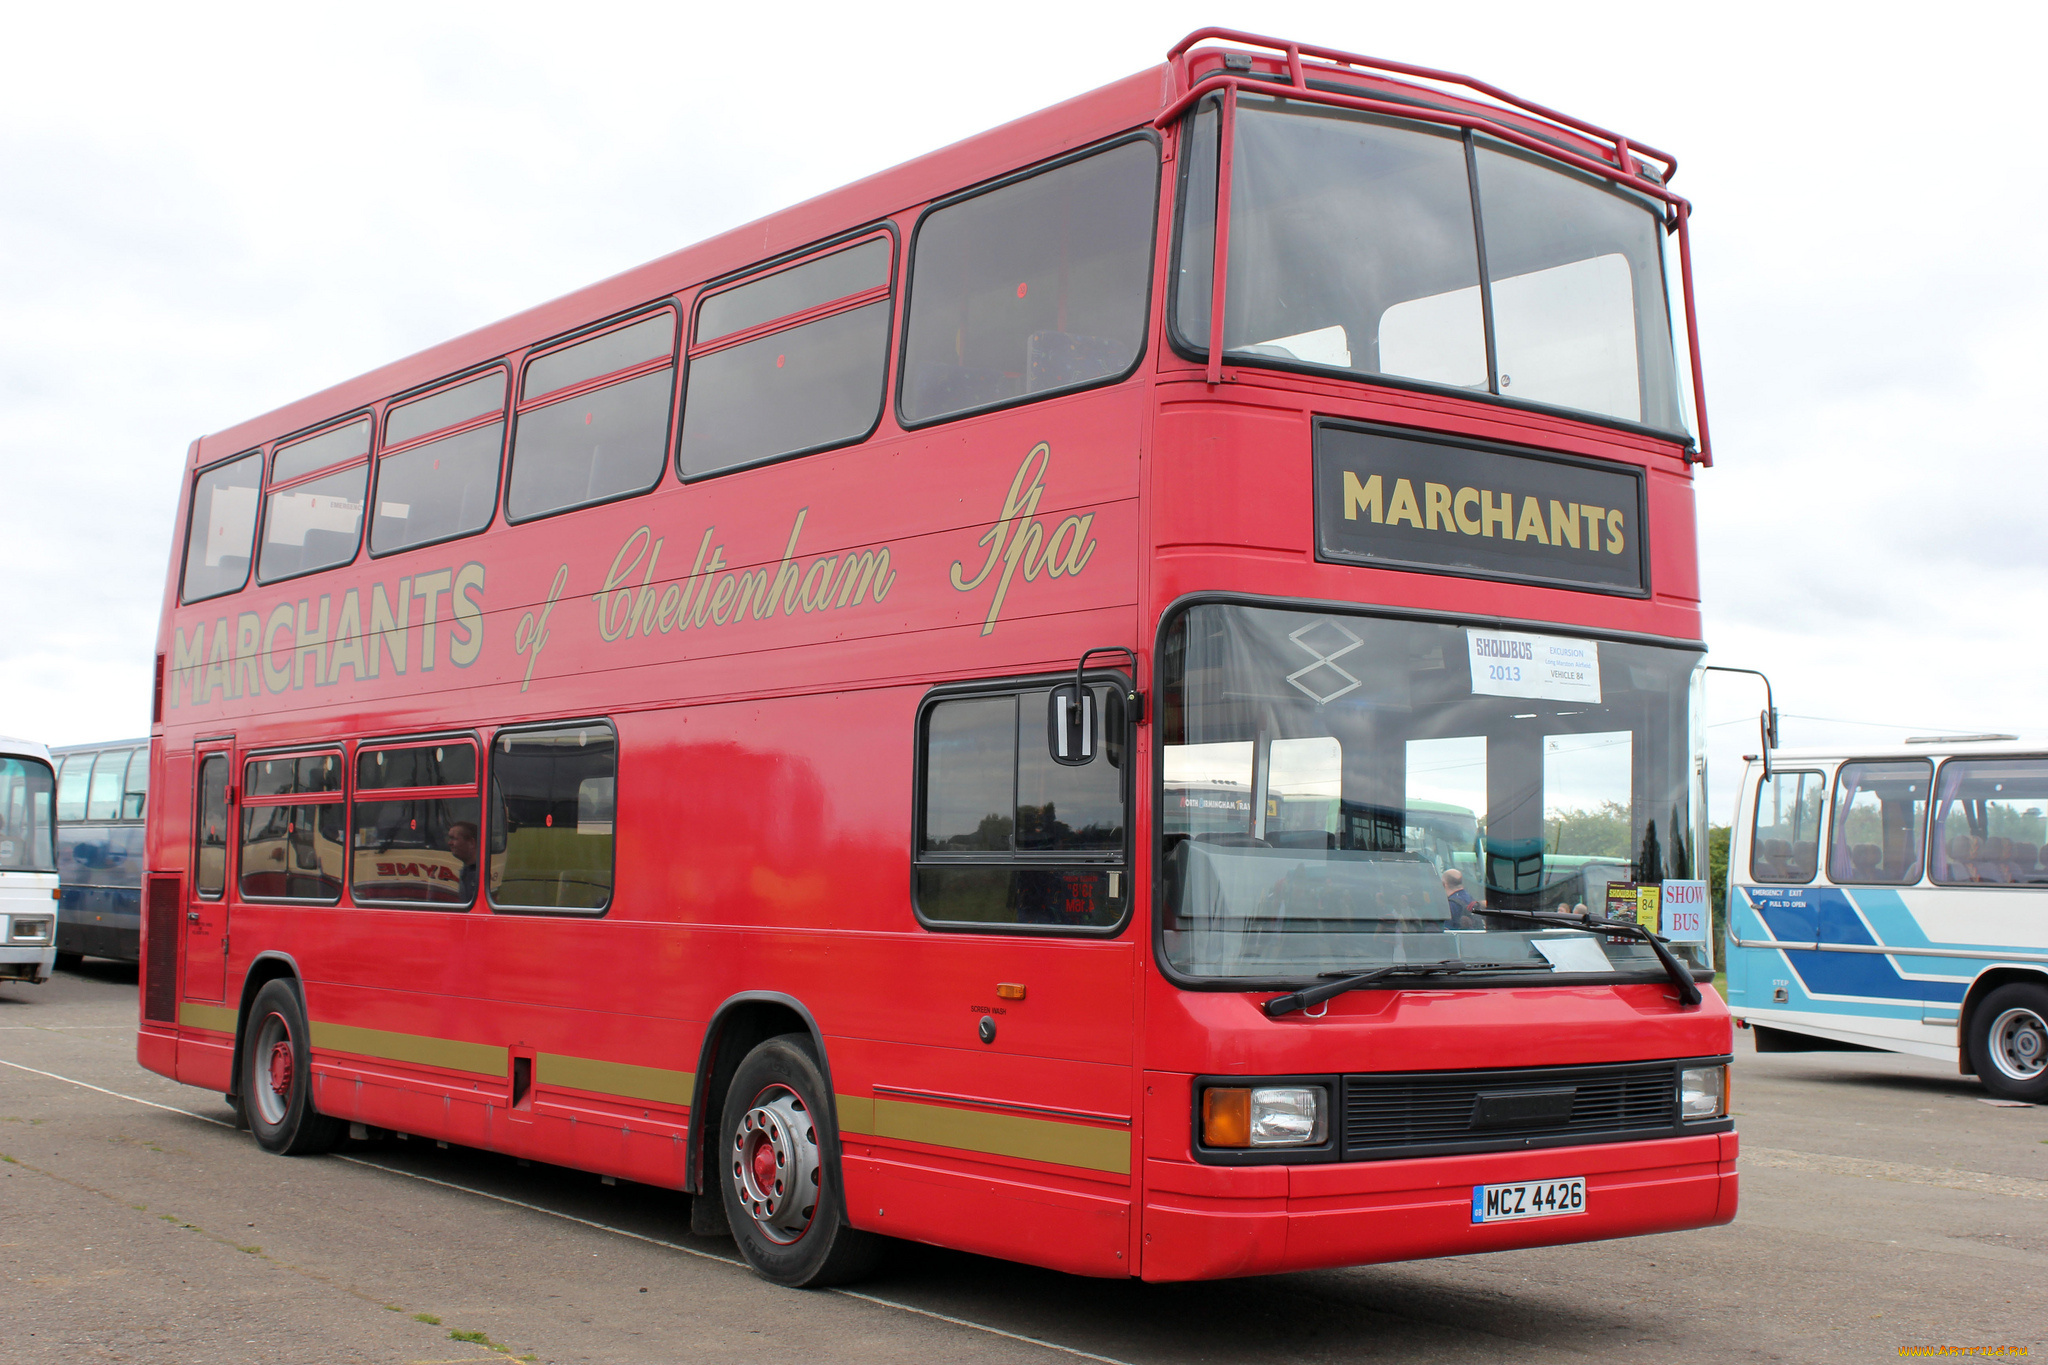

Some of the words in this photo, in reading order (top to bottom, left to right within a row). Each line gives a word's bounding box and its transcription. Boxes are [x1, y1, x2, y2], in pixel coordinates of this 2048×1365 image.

[1343, 470, 1625, 555] MARCHANTS
[169, 562, 486, 709] MARCHANTS
[513, 564, 570, 693] of
[593, 507, 897, 643] Cheltenham
[949, 441, 1097, 636] Spa
[1475, 638, 1533, 660] SHOWBUS
[1549, 646, 1584, 658] EXCURSION
[1488, 665, 1521, 682] 2013
[1551, 670, 1575, 680] VEHICLE
[1576, 671, 1584, 680] 84
[1180, 797, 1198, 808] NORTH
[1198, 797, 1236, 809] BIRMINGHAM
[1666, 886, 1705, 904] SHOW
[1752, 889, 1783, 897] EMERGENCY
[1789, 889, 1803, 897] EXIT
[1642, 899, 1654, 911] 84
[1673, 913, 1700, 931] BUS
[971, 1005, 991, 1014] SCREEN
[992, 1007, 1007, 1015] WASH
[1487, 1187, 1526, 1216] MCZ
[1532, 1182, 1582, 1211] 4426
